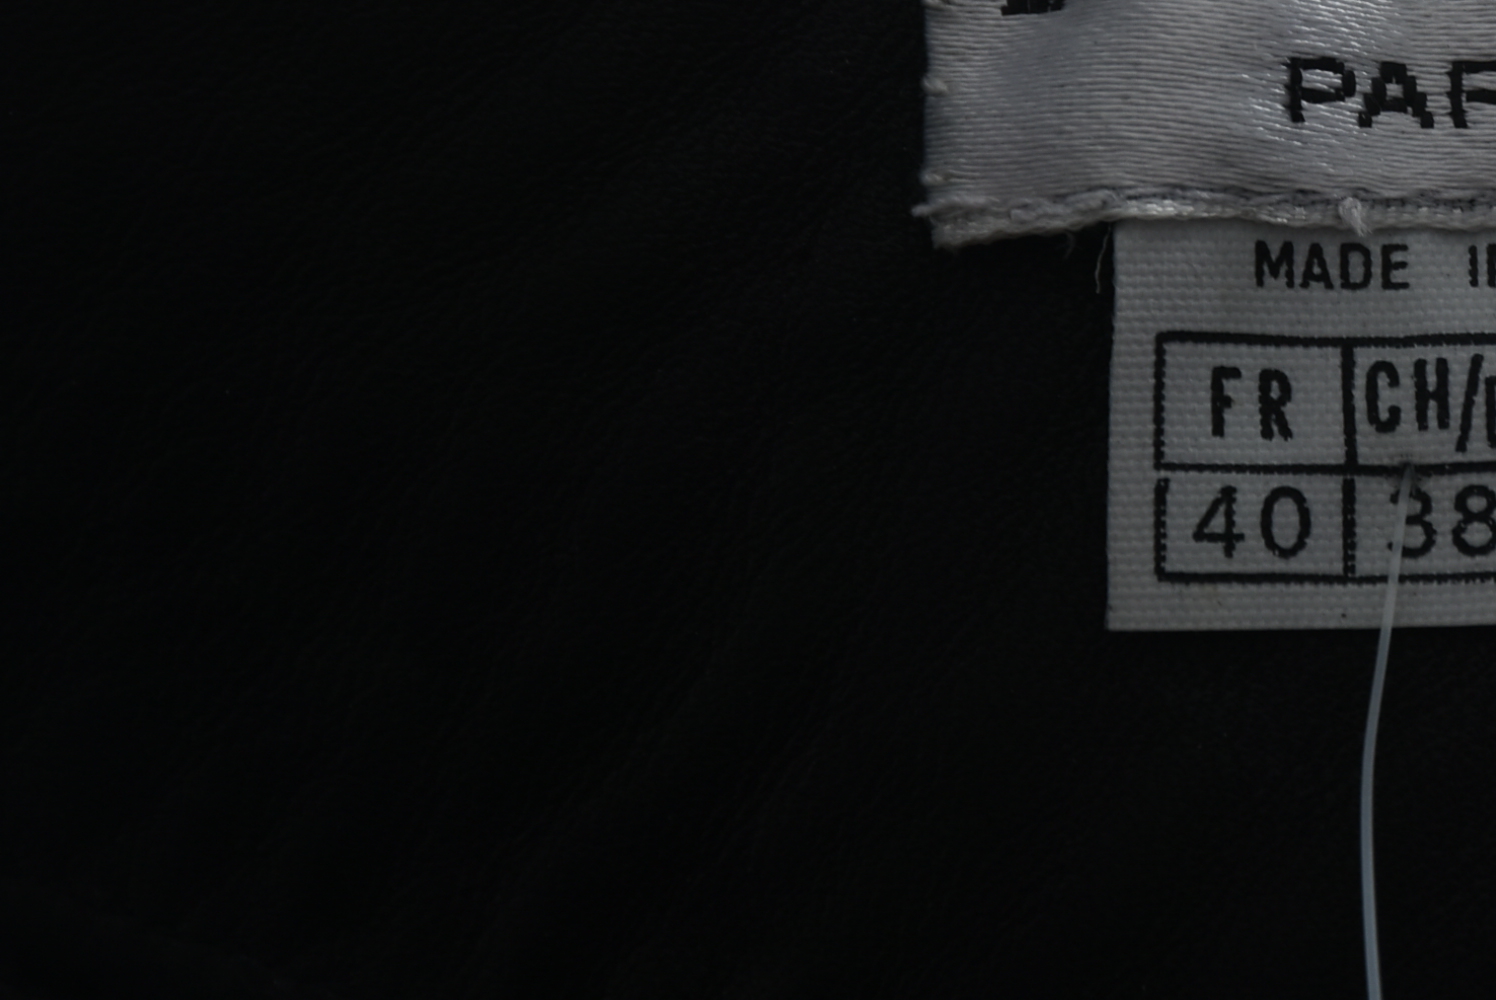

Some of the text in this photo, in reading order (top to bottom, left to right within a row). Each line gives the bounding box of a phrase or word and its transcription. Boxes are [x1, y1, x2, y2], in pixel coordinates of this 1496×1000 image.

[1254, 240, 1411, 291] MADE
[1209, 365, 1294, 441] FR
[1191, 484, 1313, 559] 40
